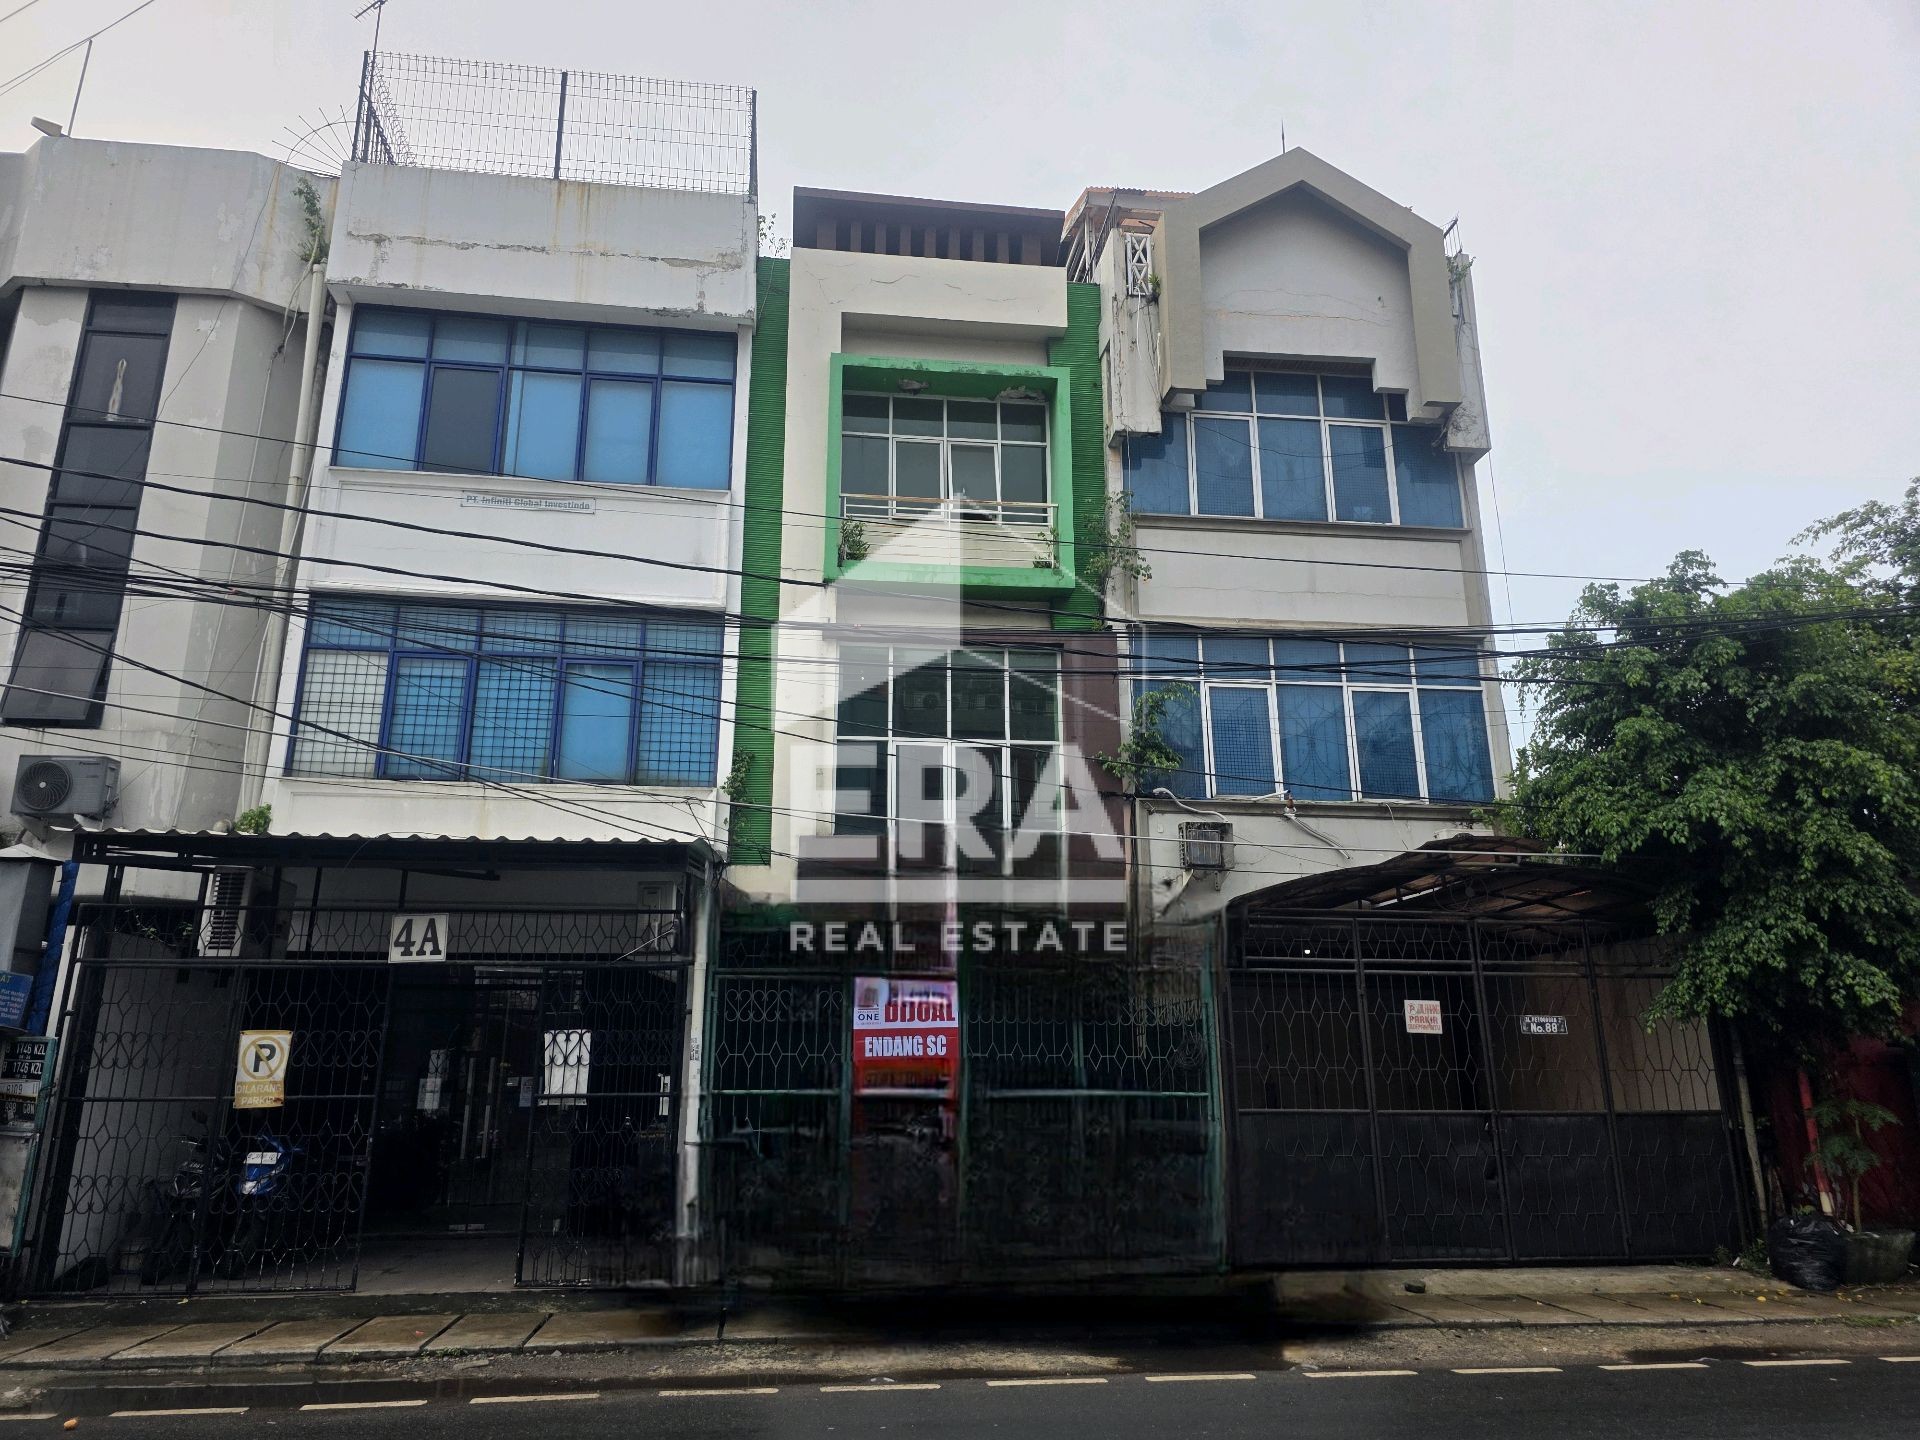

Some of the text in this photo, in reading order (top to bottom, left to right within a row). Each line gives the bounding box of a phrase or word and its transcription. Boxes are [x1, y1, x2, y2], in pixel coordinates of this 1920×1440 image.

[466, 495, 479, 504] PT.
[514, 498, 542, 507] Global
[544, 500, 590, 510] Investindo
[393, 917, 442, 957] 4A
[858, 1013, 880, 1021] ONE
[1409, 1015, 1438, 1024] PARKIR
[864, 1034, 947, 1057] ENDANG SC
[13, 1061, 29, 1074] 1746
[30, 1062, 42, 1075] KZL
